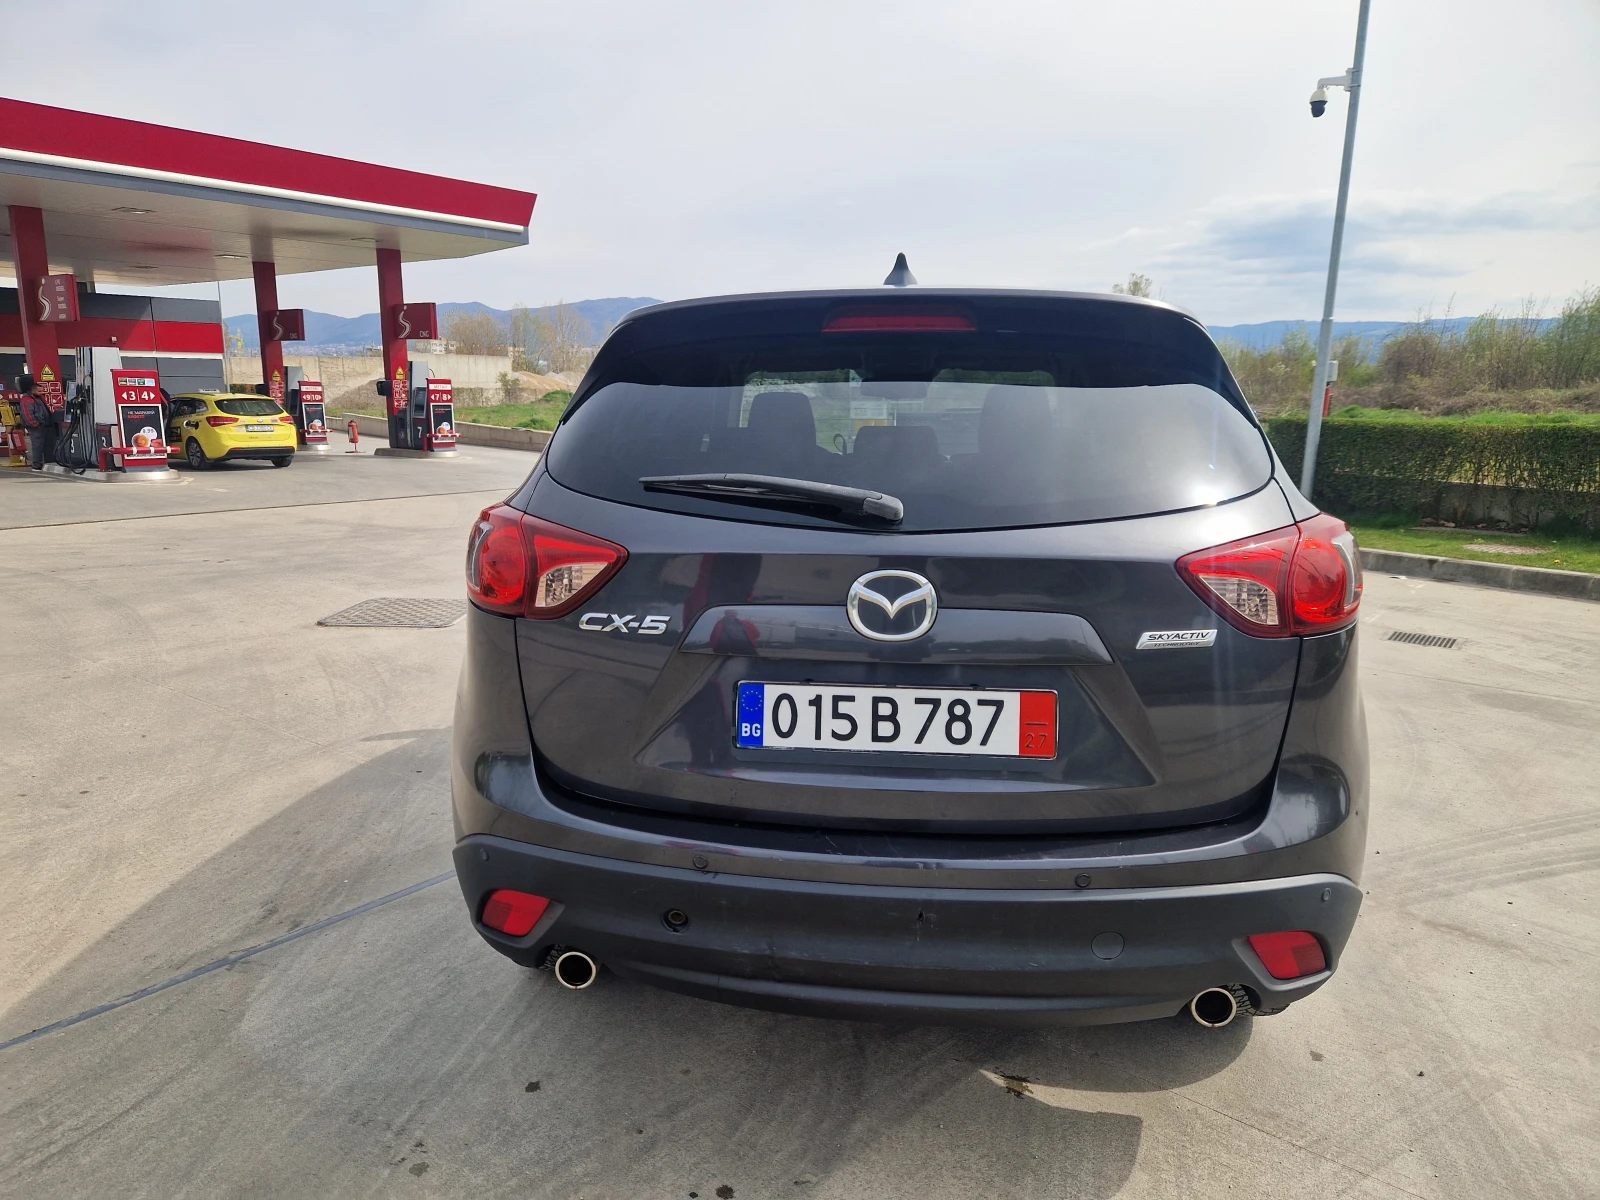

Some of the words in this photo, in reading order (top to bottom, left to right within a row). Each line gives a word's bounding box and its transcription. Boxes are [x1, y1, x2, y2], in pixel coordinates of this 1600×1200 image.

[128, 391, 136, 401] 3
[141, 391, 149, 401] 4
[434, 393, 440, 401] 7
[442, 393, 448, 401] 8
[417, 426, 423, 439] 7
[578, 612, 671, 635] CX-5
[1147, 631, 1210, 641] SKYACTIV
[741, 722, 761, 738] BG
[1024, 733, 1048, 750] 27
